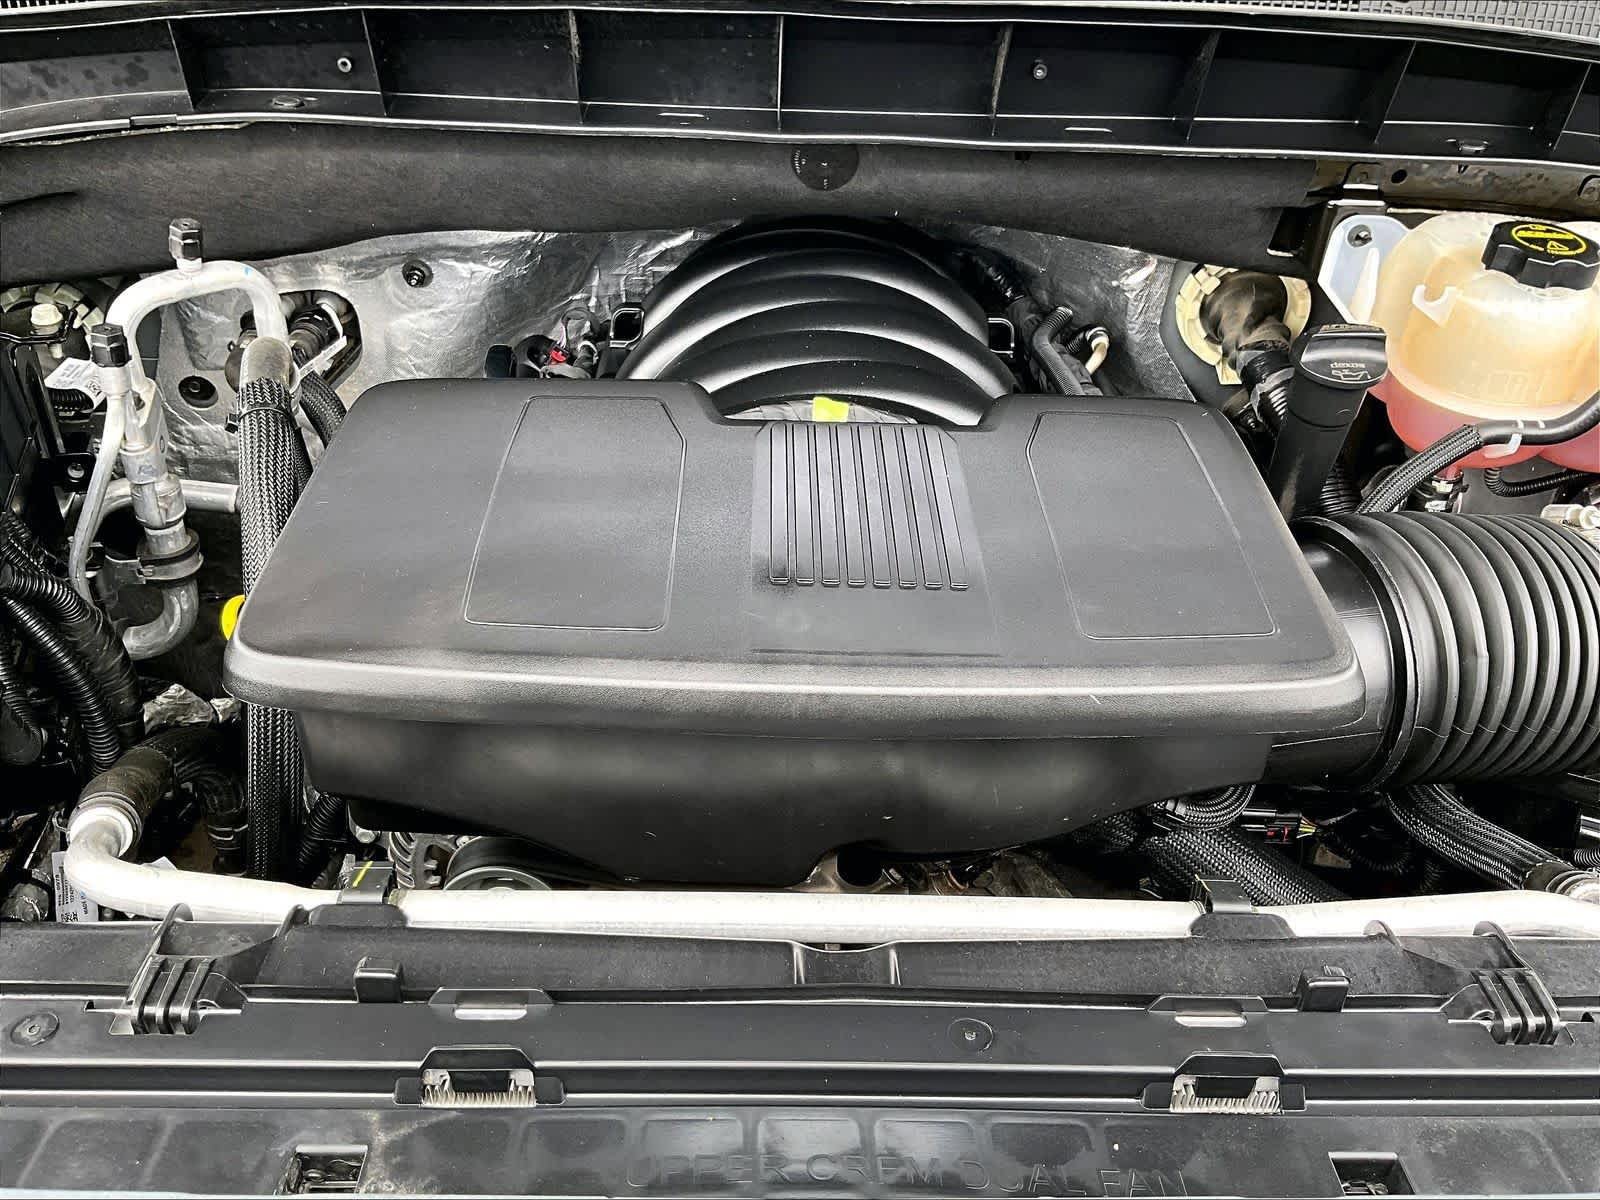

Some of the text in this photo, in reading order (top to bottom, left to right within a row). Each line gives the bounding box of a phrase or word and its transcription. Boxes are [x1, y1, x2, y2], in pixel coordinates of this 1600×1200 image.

[1330, 361, 1366, 369] dexos
[625, 1153, 794, 1187] UPPER
[956, 1159, 1088, 1197] DUAL
[1099, 1167, 1189, 1198] FAN
